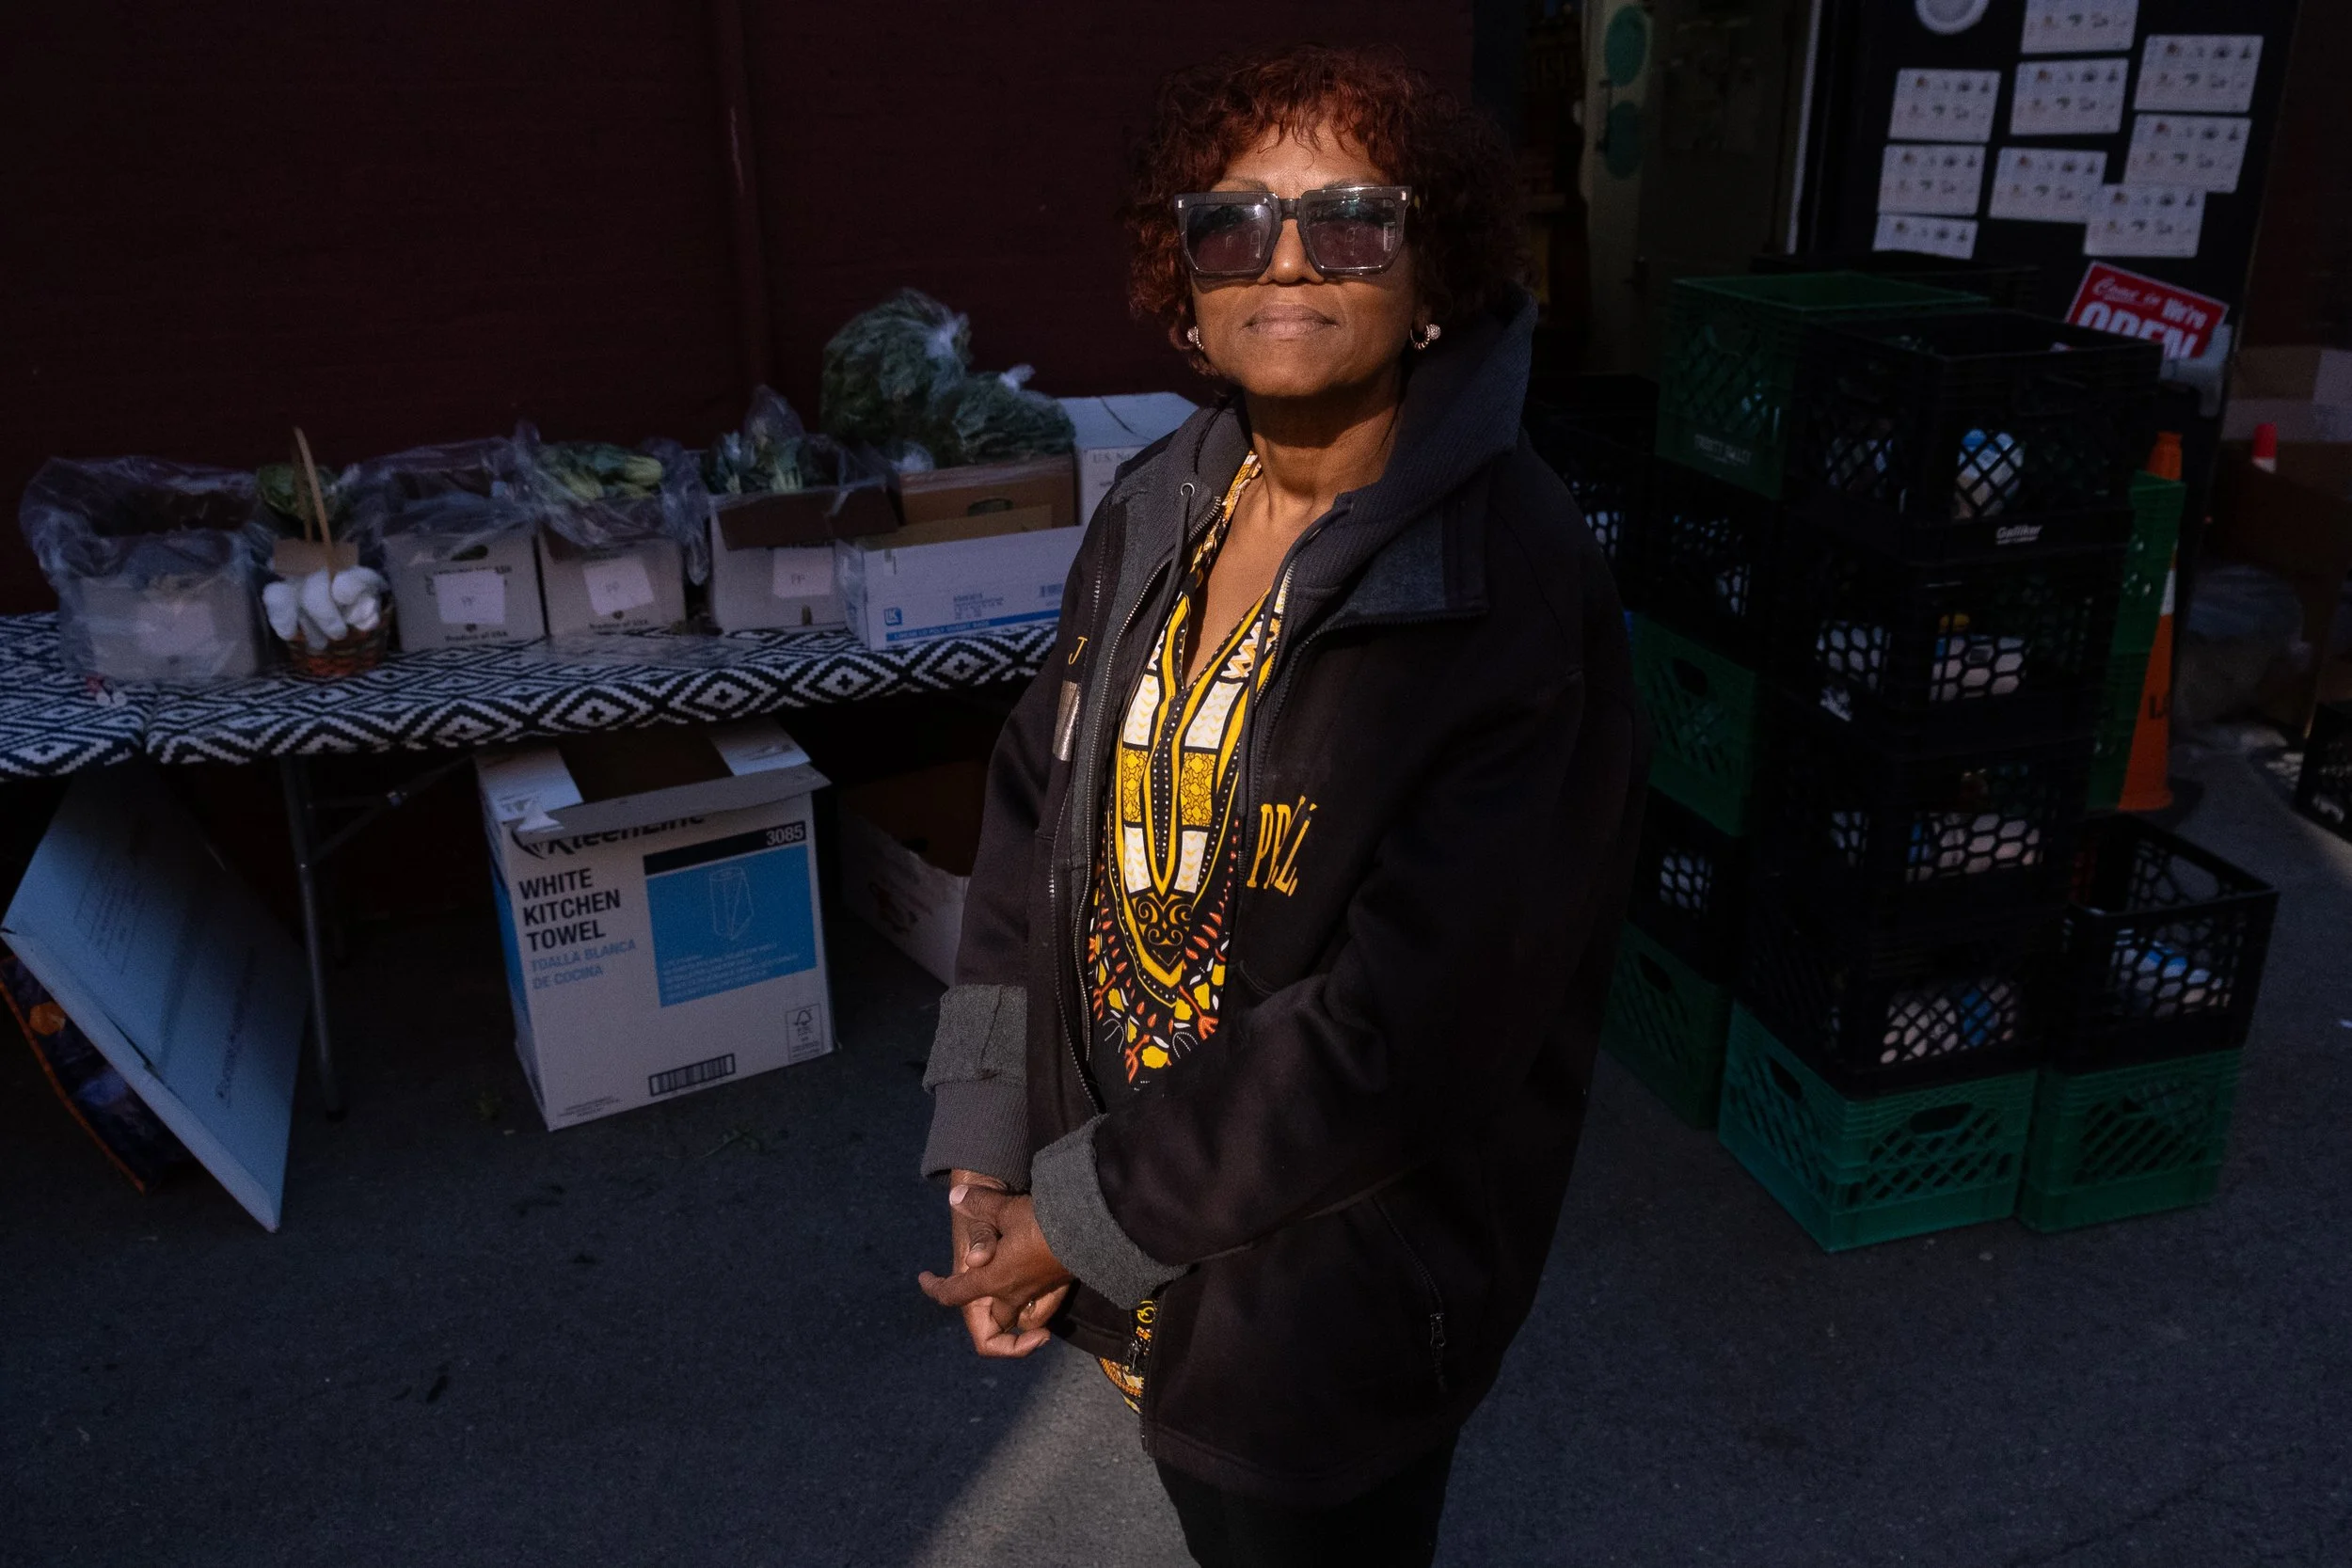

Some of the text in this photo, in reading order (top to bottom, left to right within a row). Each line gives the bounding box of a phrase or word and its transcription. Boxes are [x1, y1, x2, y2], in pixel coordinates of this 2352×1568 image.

[1068, 636, 1089, 666] J
[766, 824, 804, 847] 3085
[518, 868, 594, 900] WHITE
[523, 889, 622, 927] KITCHEN
[527, 920, 606, 952] TOWEL
[584, 940, 637, 961] BLANCA
